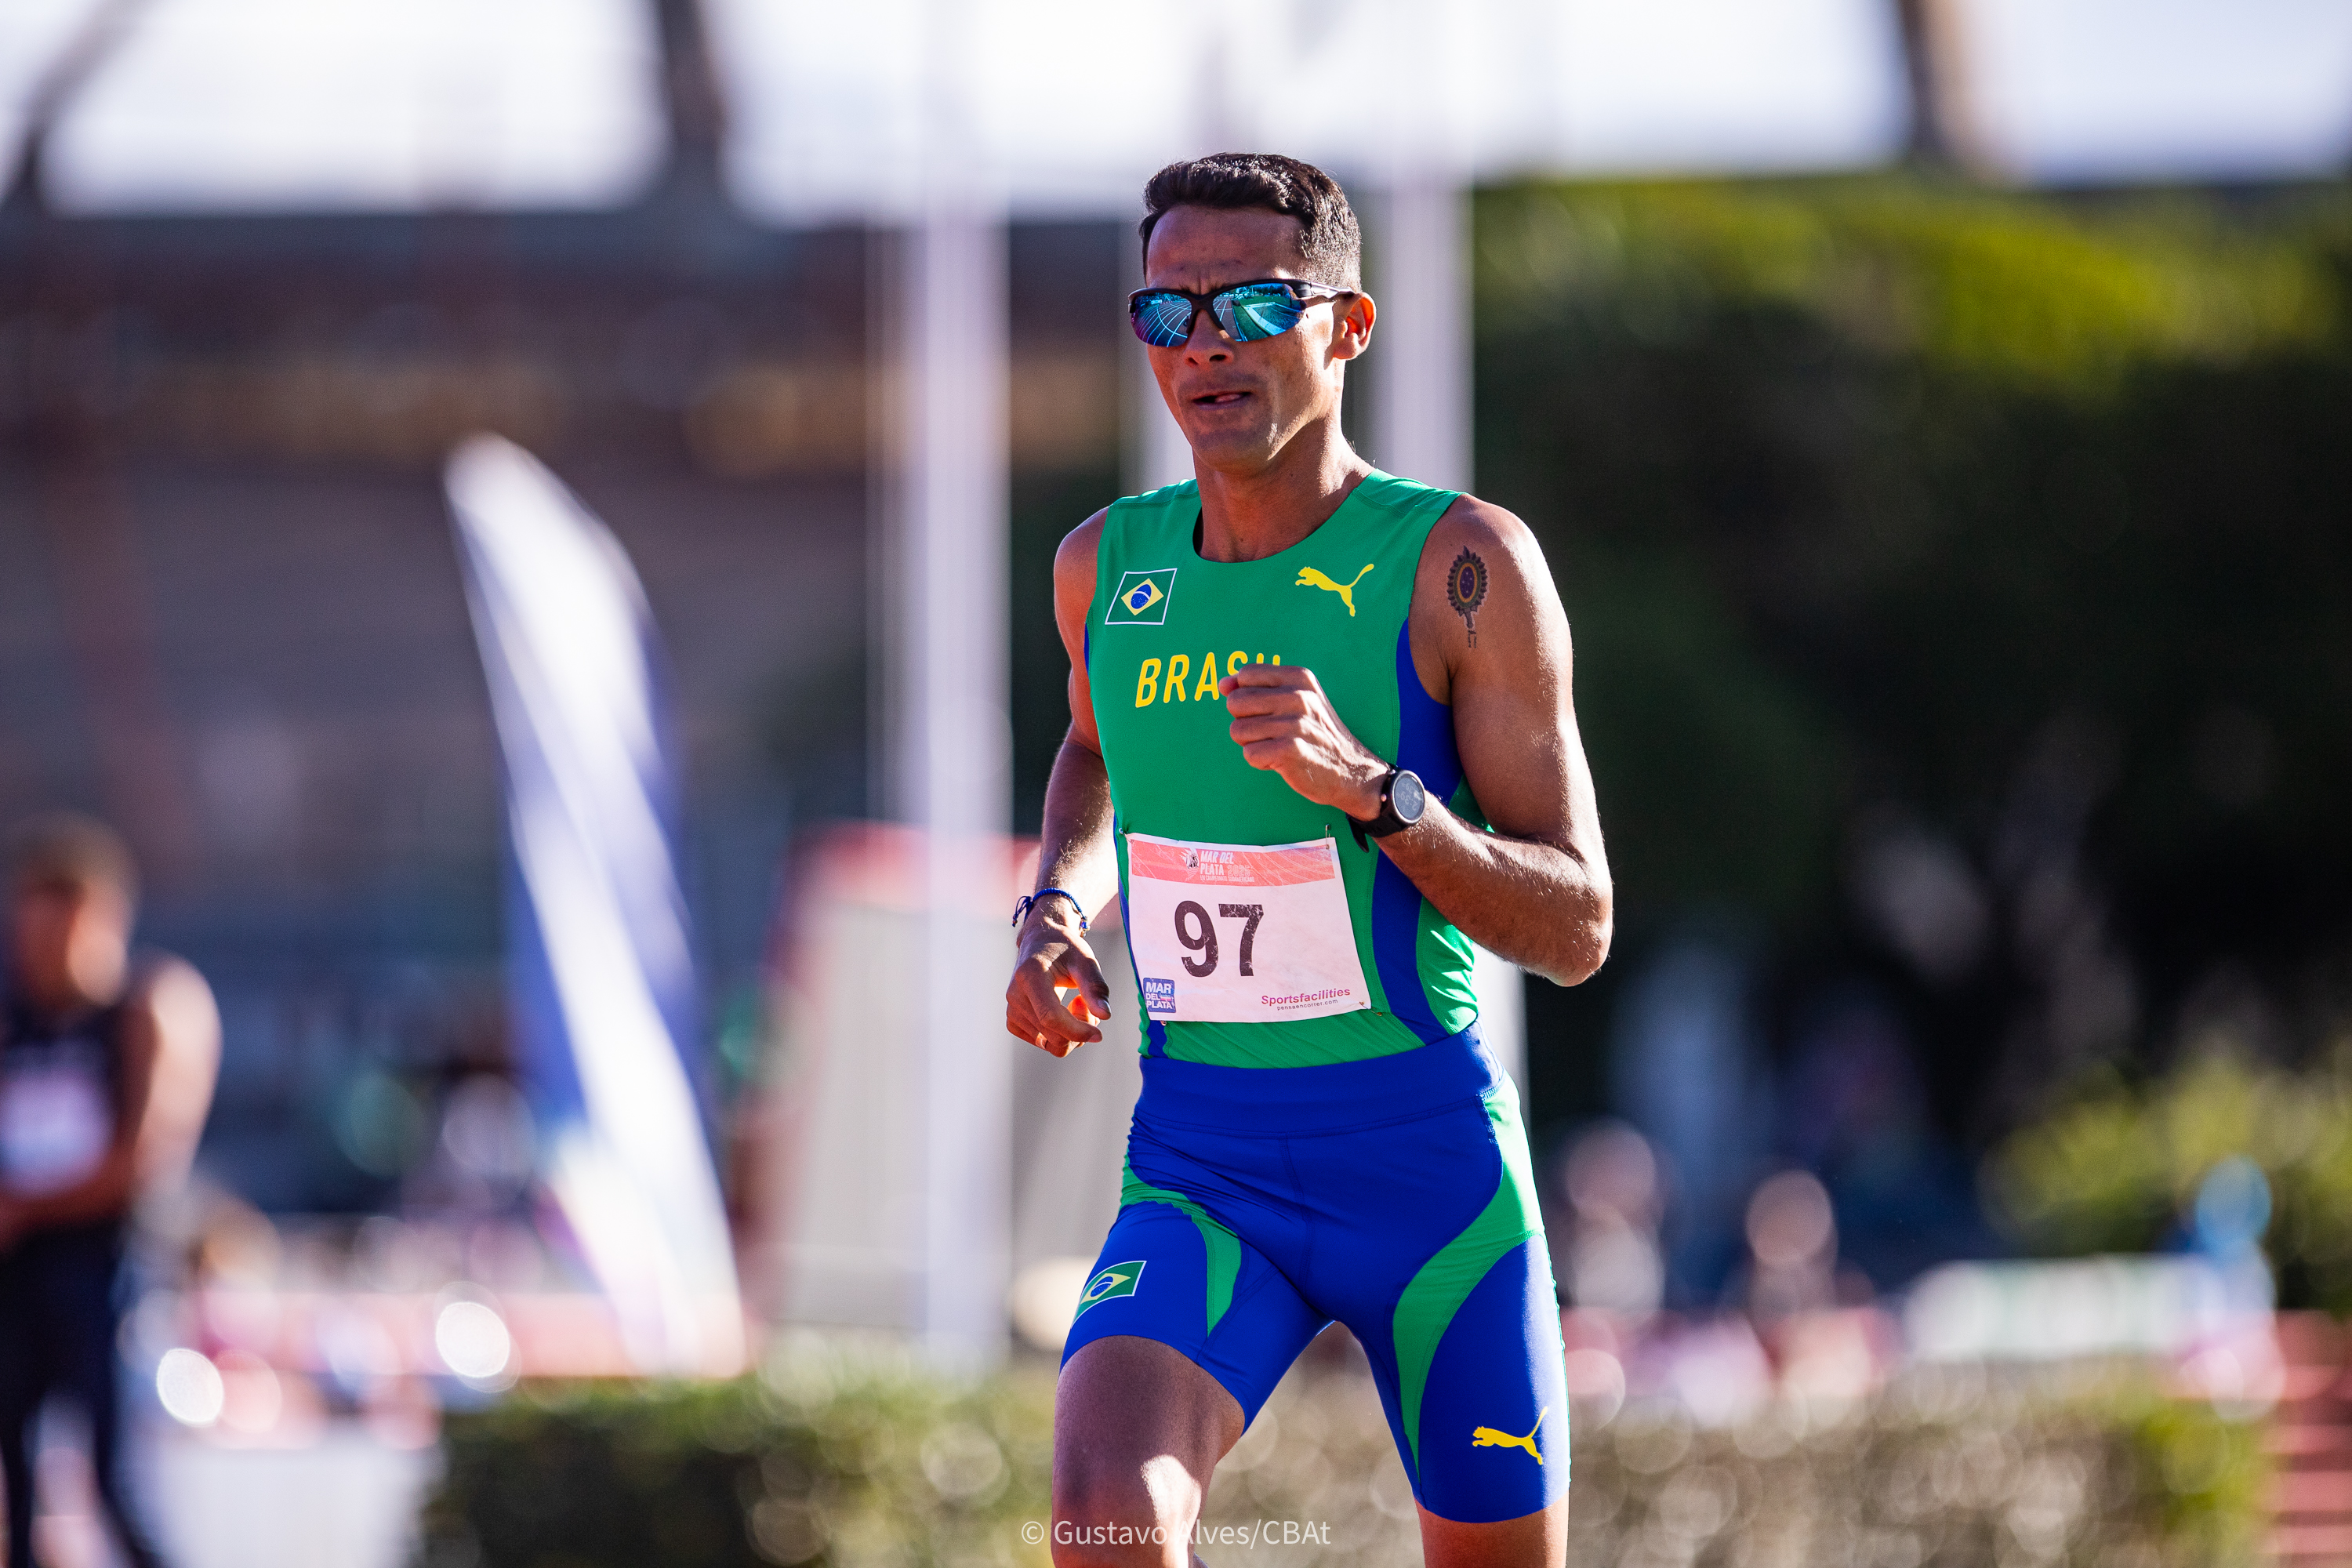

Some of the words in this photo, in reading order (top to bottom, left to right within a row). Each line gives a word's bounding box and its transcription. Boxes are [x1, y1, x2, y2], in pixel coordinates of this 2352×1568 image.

[1135, 651, 1281, 708] BRA
[1201, 851, 1219, 863] MAR
[1219, 851, 1234, 864] DEL
[1200, 863, 1225, 876] PLATA
[1227, 864, 1250, 877] 2025
[1174, 900, 1265, 978] 97
[1145, 982, 1172, 994] MAR
[1261, 988, 1351, 1007] Sportsfacilities
[1146, 1000, 1173, 1009] PLATA
[1276, 999, 1338, 1011] pensaencorrer.com
